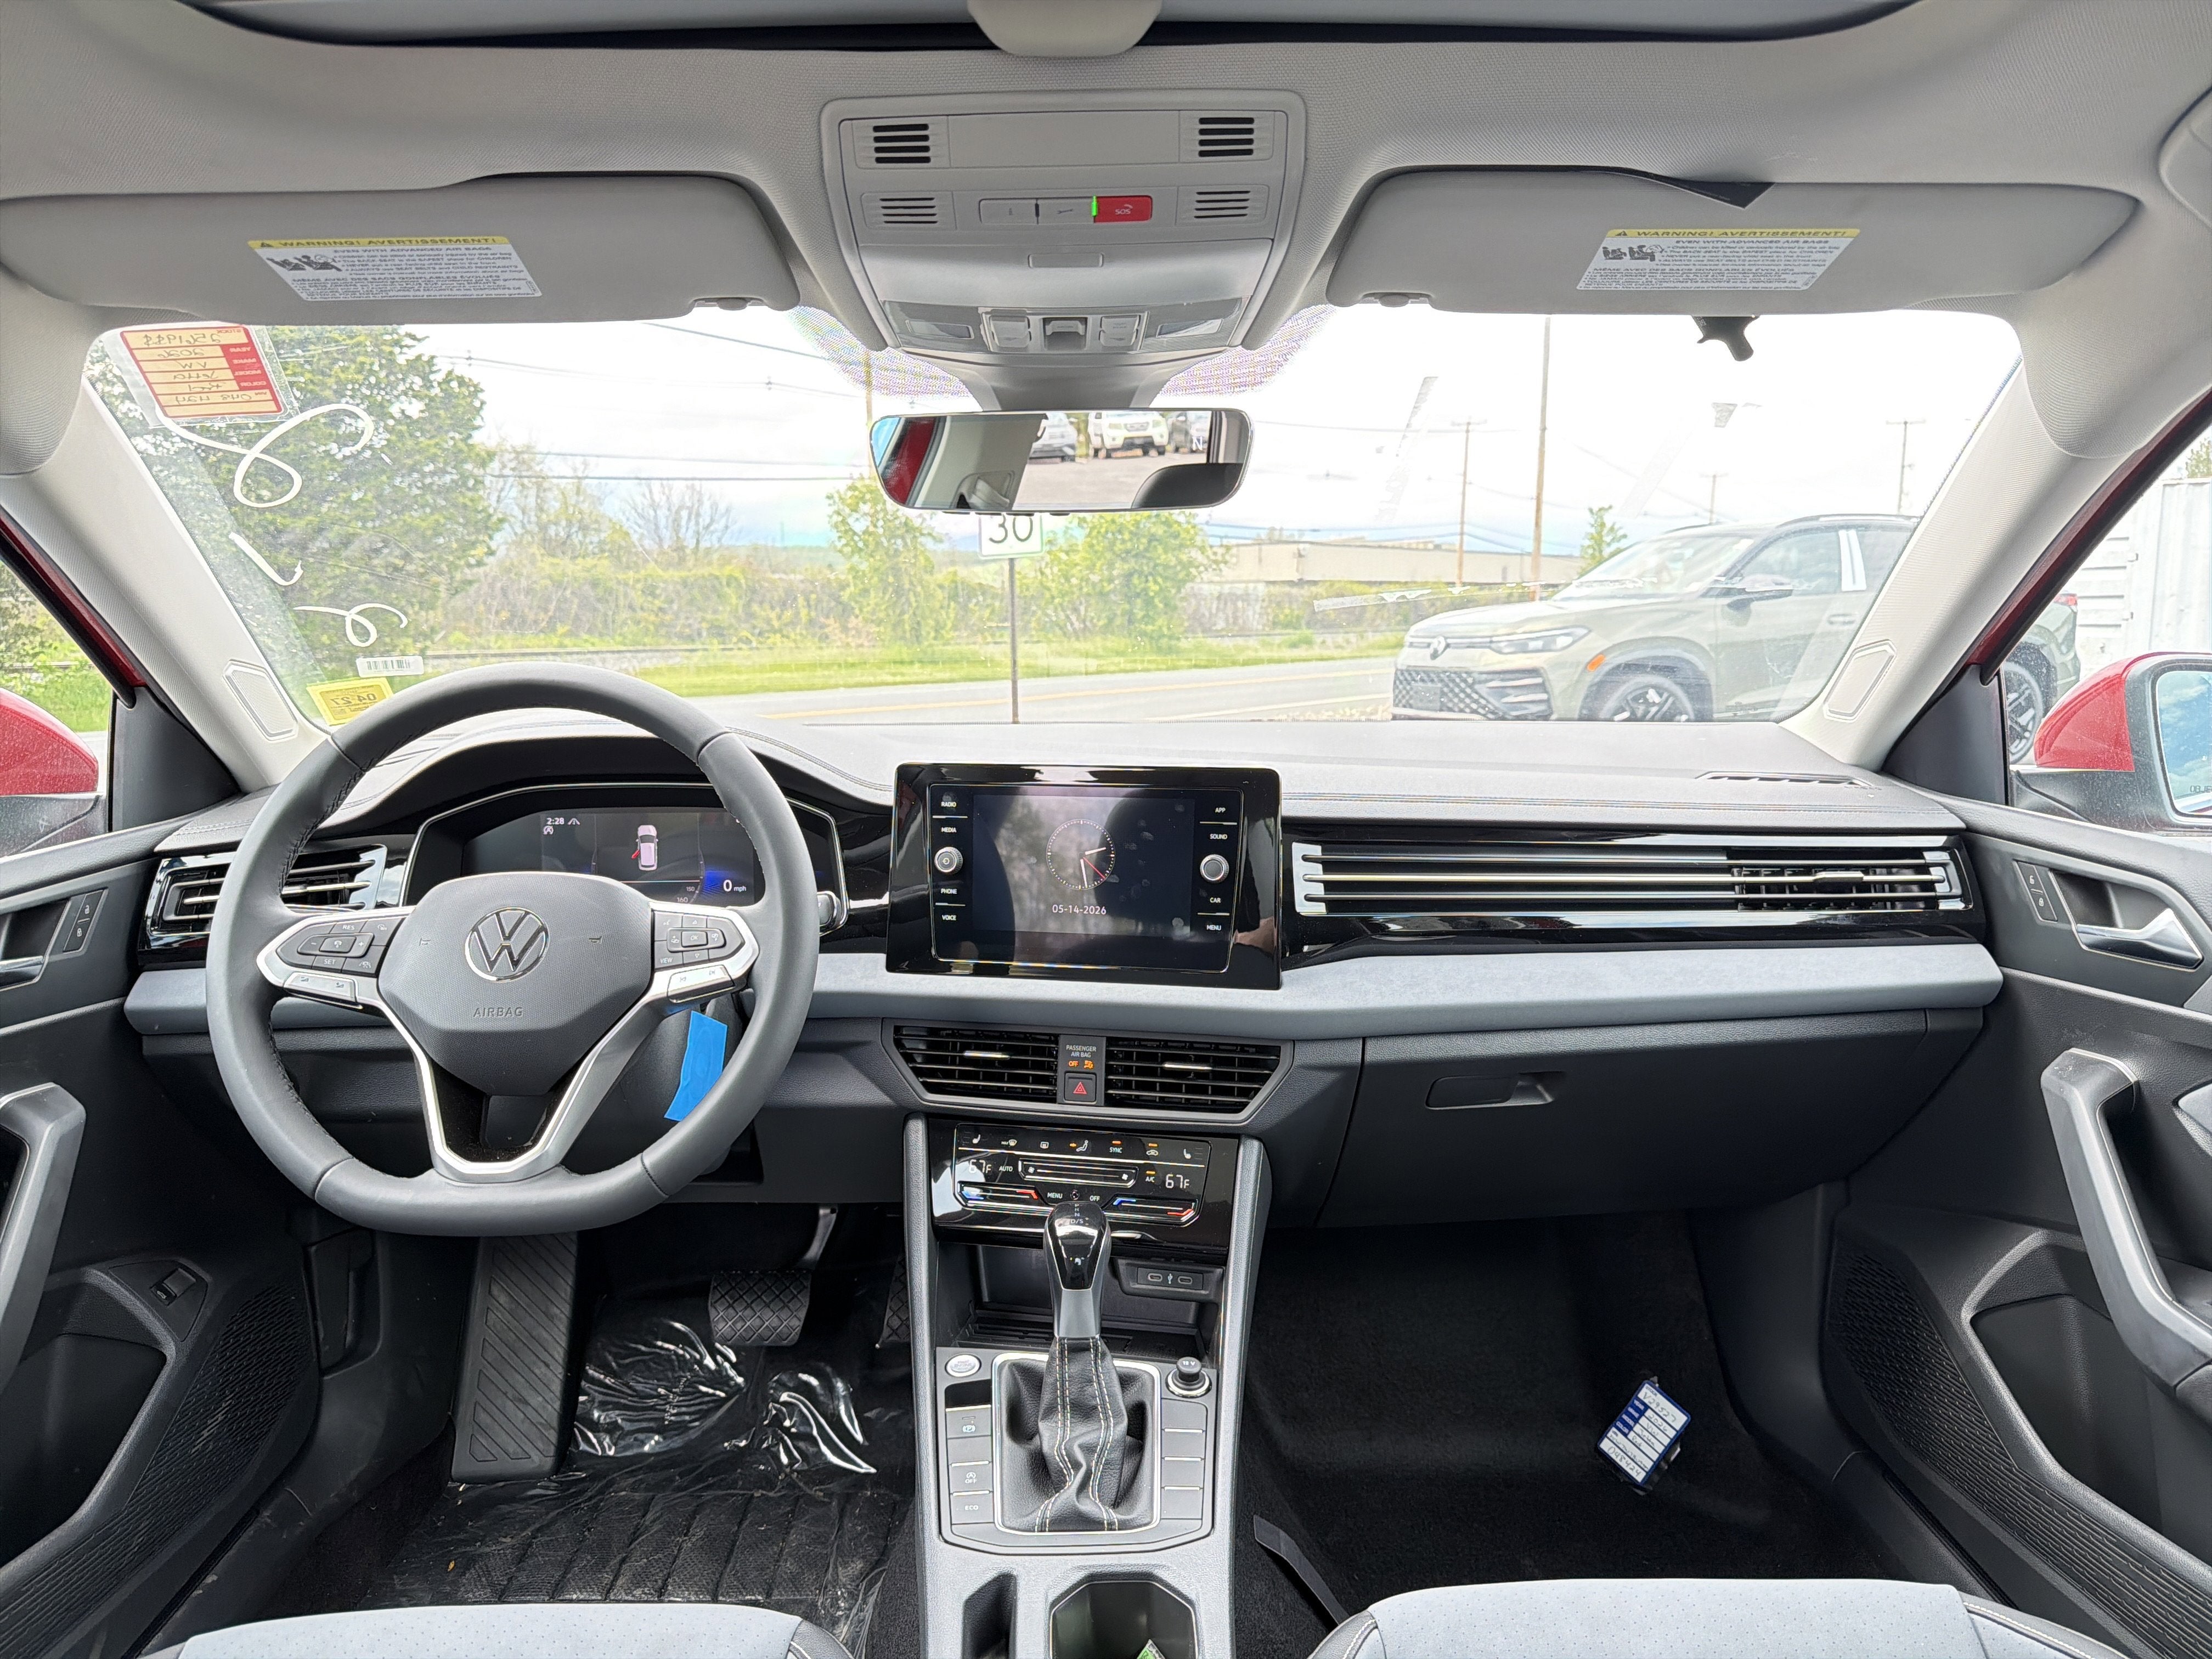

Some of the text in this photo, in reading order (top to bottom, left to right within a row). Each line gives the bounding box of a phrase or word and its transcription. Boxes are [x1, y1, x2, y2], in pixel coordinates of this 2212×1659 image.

[1192, 436, 1203, 450] N
[989, 514, 1033, 543] 30
[723, 879, 732, 892] 0
[1052, 904, 1107, 916] 05-14-2026
[473, 1006, 523, 1019] AIRBAG
[1066, 1044, 1097, 1052] PASSENGER
